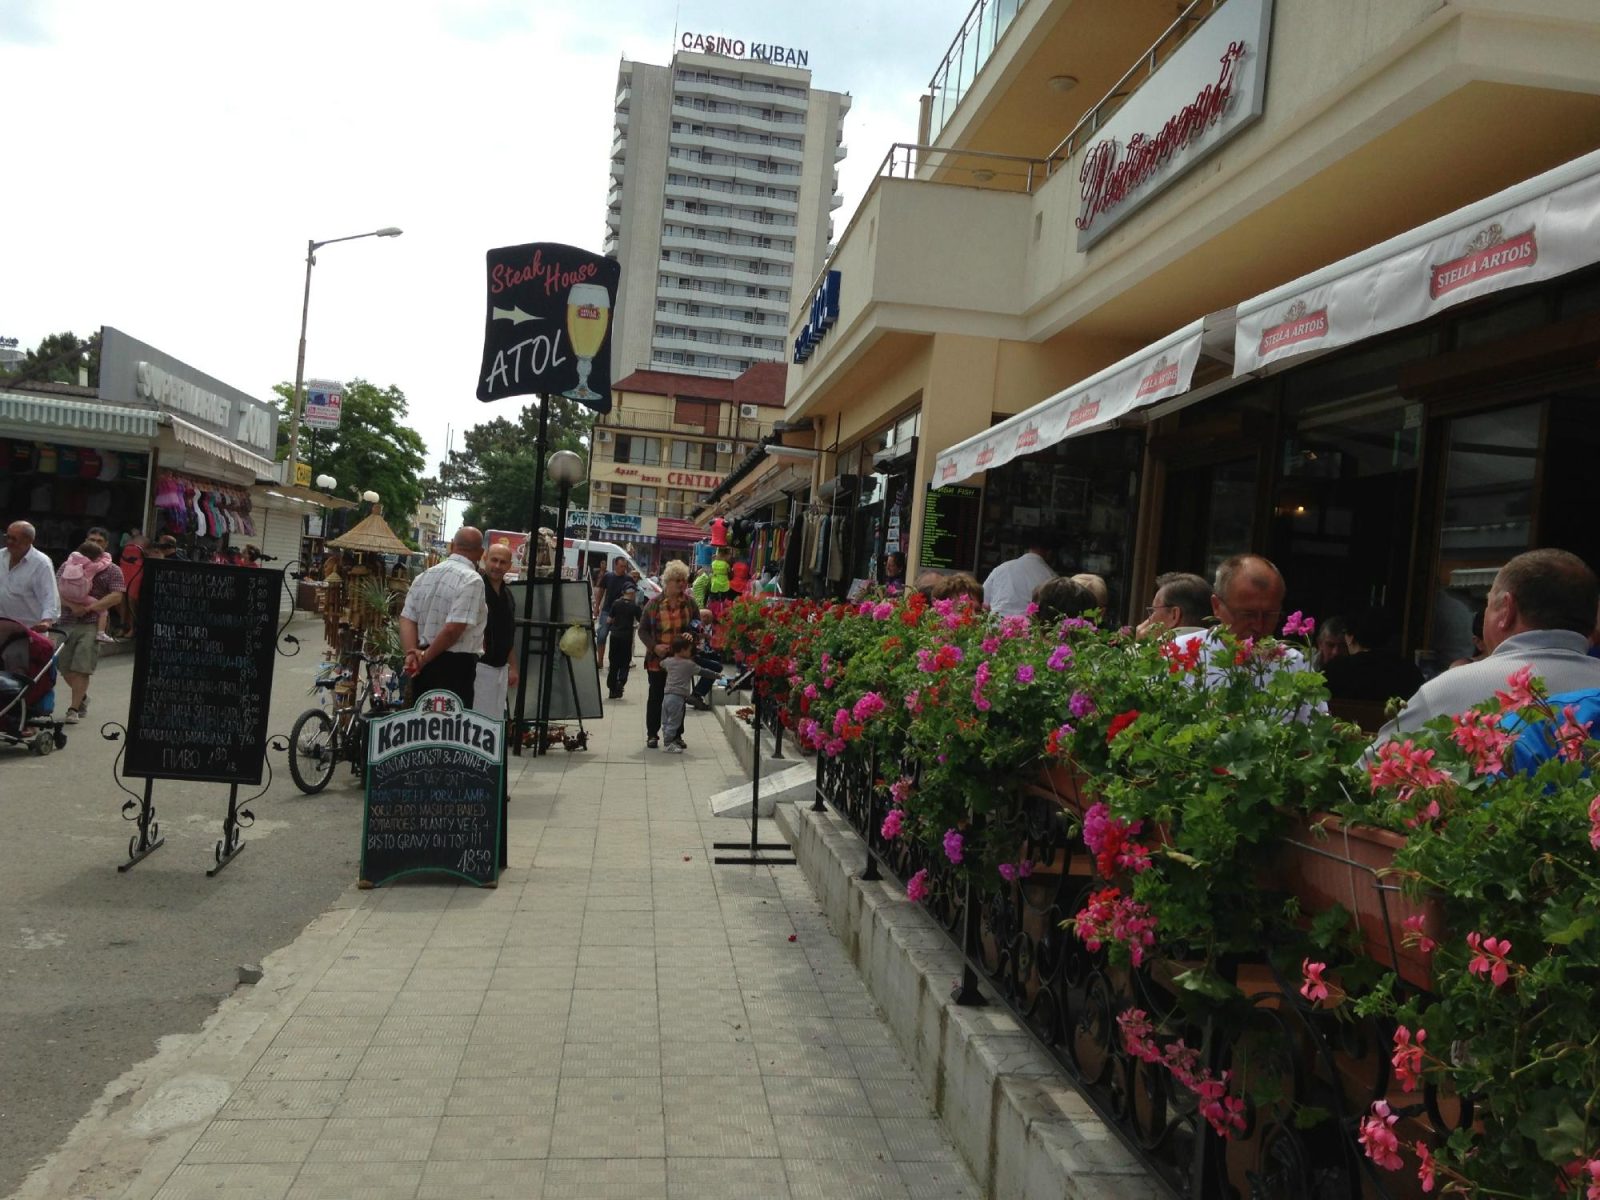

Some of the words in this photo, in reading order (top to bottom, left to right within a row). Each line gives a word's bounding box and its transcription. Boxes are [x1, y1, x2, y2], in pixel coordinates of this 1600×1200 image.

[682, 32, 745, 56] CASINO
[750, 42, 809, 66] KUBAN
[491, 248, 545, 293] Steak
[544, 262, 597, 296] House
[1437, 261, 1477, 288] STELLA
[1480, 241, 1531, 271] ARTOIS
[1264, 328, 1290, 348] STELLA
[1291, 317, 1324, 337] ARTOIS
[486, 328, 566, 393] ATOL
[667, 472, 728, 488] CENTRA
[378, 714, 496, 755] Kamenitza
[162, 748, 201, 769] ПИВО
[375, 752, 411, 779] SUNDAY
[443, 750, 452, 763] &
[453, 750, 491, 775] DINNER
[367, 833, 395, 849] BISTO
[396, 833, 431, 851] GRAVY
